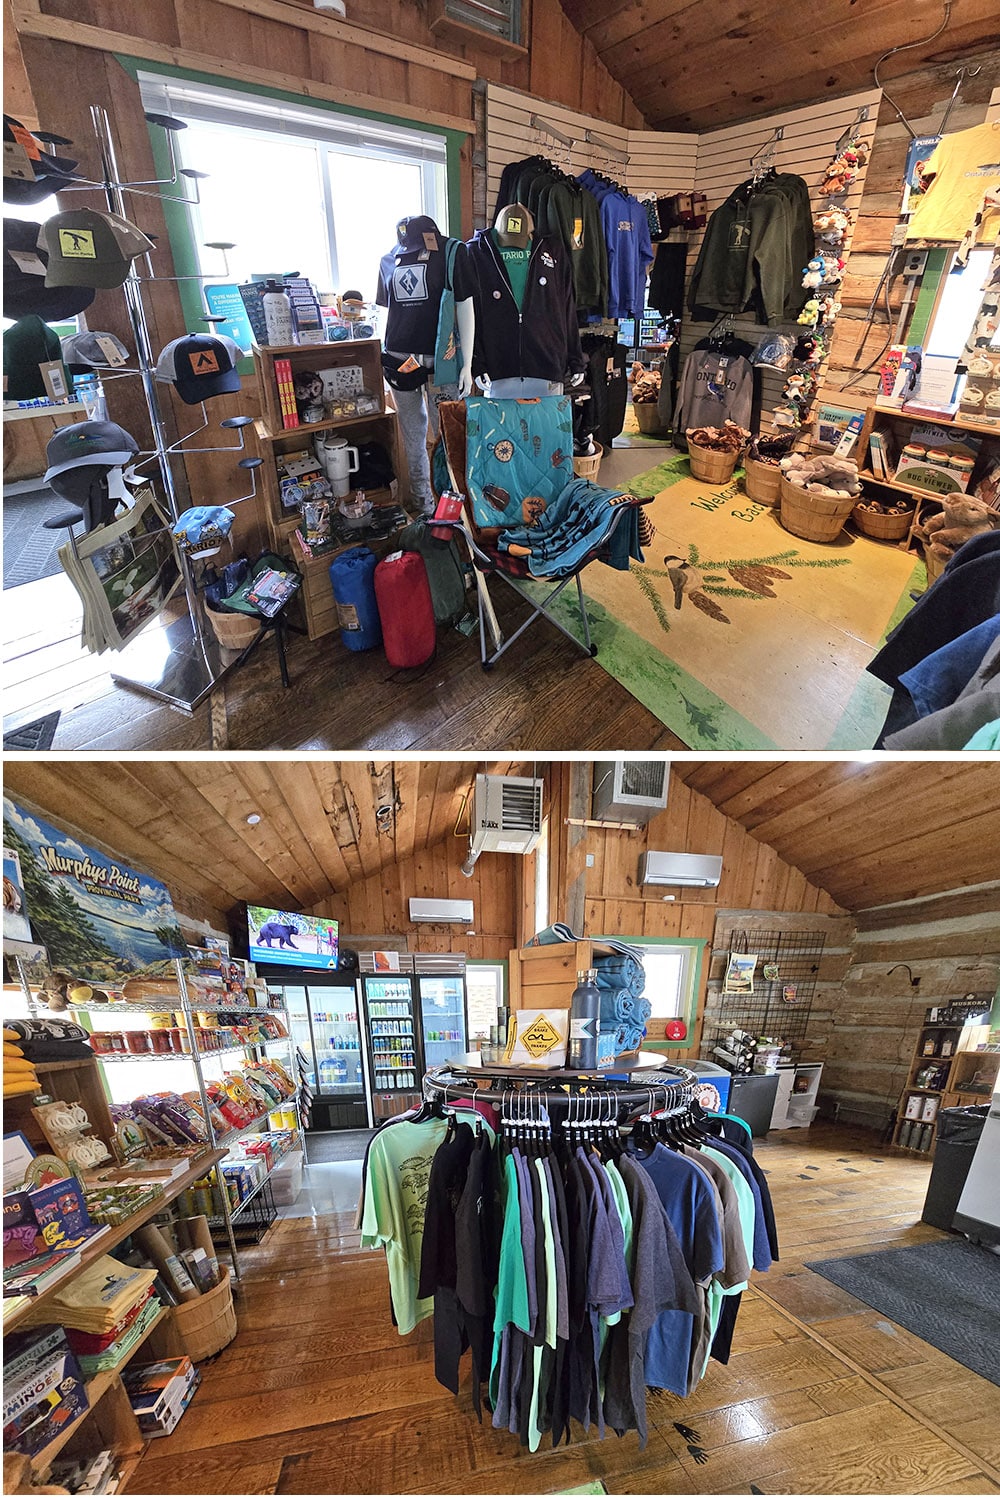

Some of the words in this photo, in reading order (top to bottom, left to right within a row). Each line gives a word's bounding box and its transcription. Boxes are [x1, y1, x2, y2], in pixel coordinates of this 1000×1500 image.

[907, 473, 922, 482] BUG
[924, 477, 953, 489] VIEWER
[731, 504, 769, 523] Bac
[40, 846, 107, 883] Murphys
[109, 866, 140, 892] Point
[86, 884, 123, 900] PROVINCIAL
[123, 893, 143, 905] PARK
